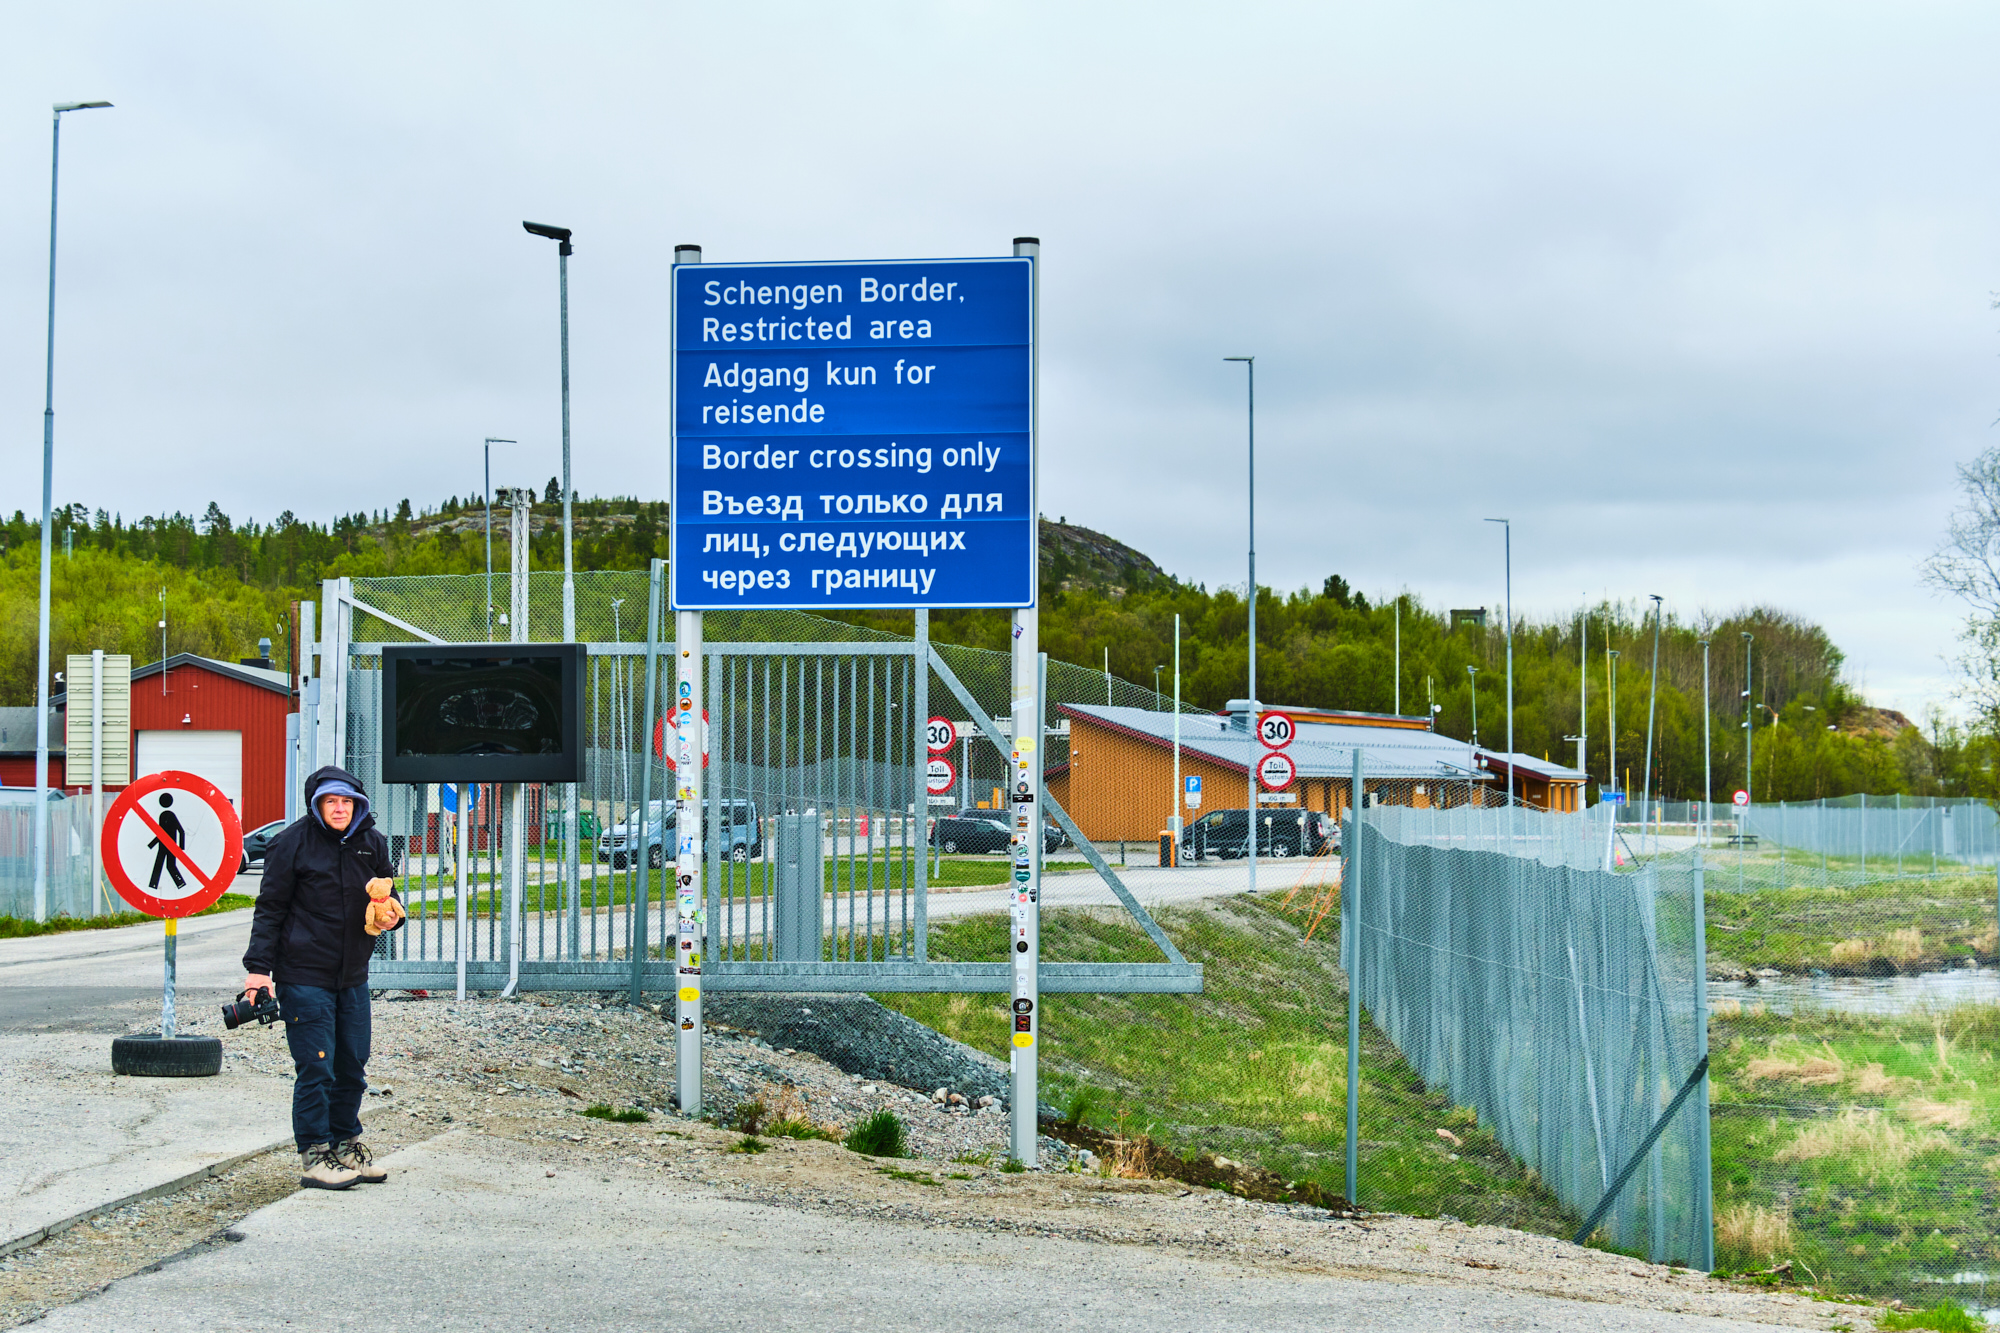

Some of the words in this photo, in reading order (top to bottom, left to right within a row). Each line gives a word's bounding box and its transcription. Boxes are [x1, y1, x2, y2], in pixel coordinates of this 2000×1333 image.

[704, 280, 842, 310] Schengen
[860, 277, 965, 303] Border,
[703, 315, 852, 342] Restricted
[869, 319, 932, 340] area
[703, 361, 809, 394] Adgang
[826, 360, 877, 386] kun
[894, 359, 936, 385] for
[702, 397, 825, 424] reisende
[703, 444, 800, 470] Border
[809, 442, 932, 474] crossing
[942, 441, 1001, 473] only
[702, 490, 804, 522] Въезд
[819, 493, 928, 515] только
[940, 492, 1003, 520] для
[702, 532, 770, 559] лиц,
[779, 531, 966, 558] следующих
[702, 569, 791, 596] через
[811, 568, 936, 596] границу
[927, 726, 949, 744] 30
[1264, 721, 1289, 739] 30
[930, 765, 945, 773] Toll
[1189, 778, 1198, 791] P
